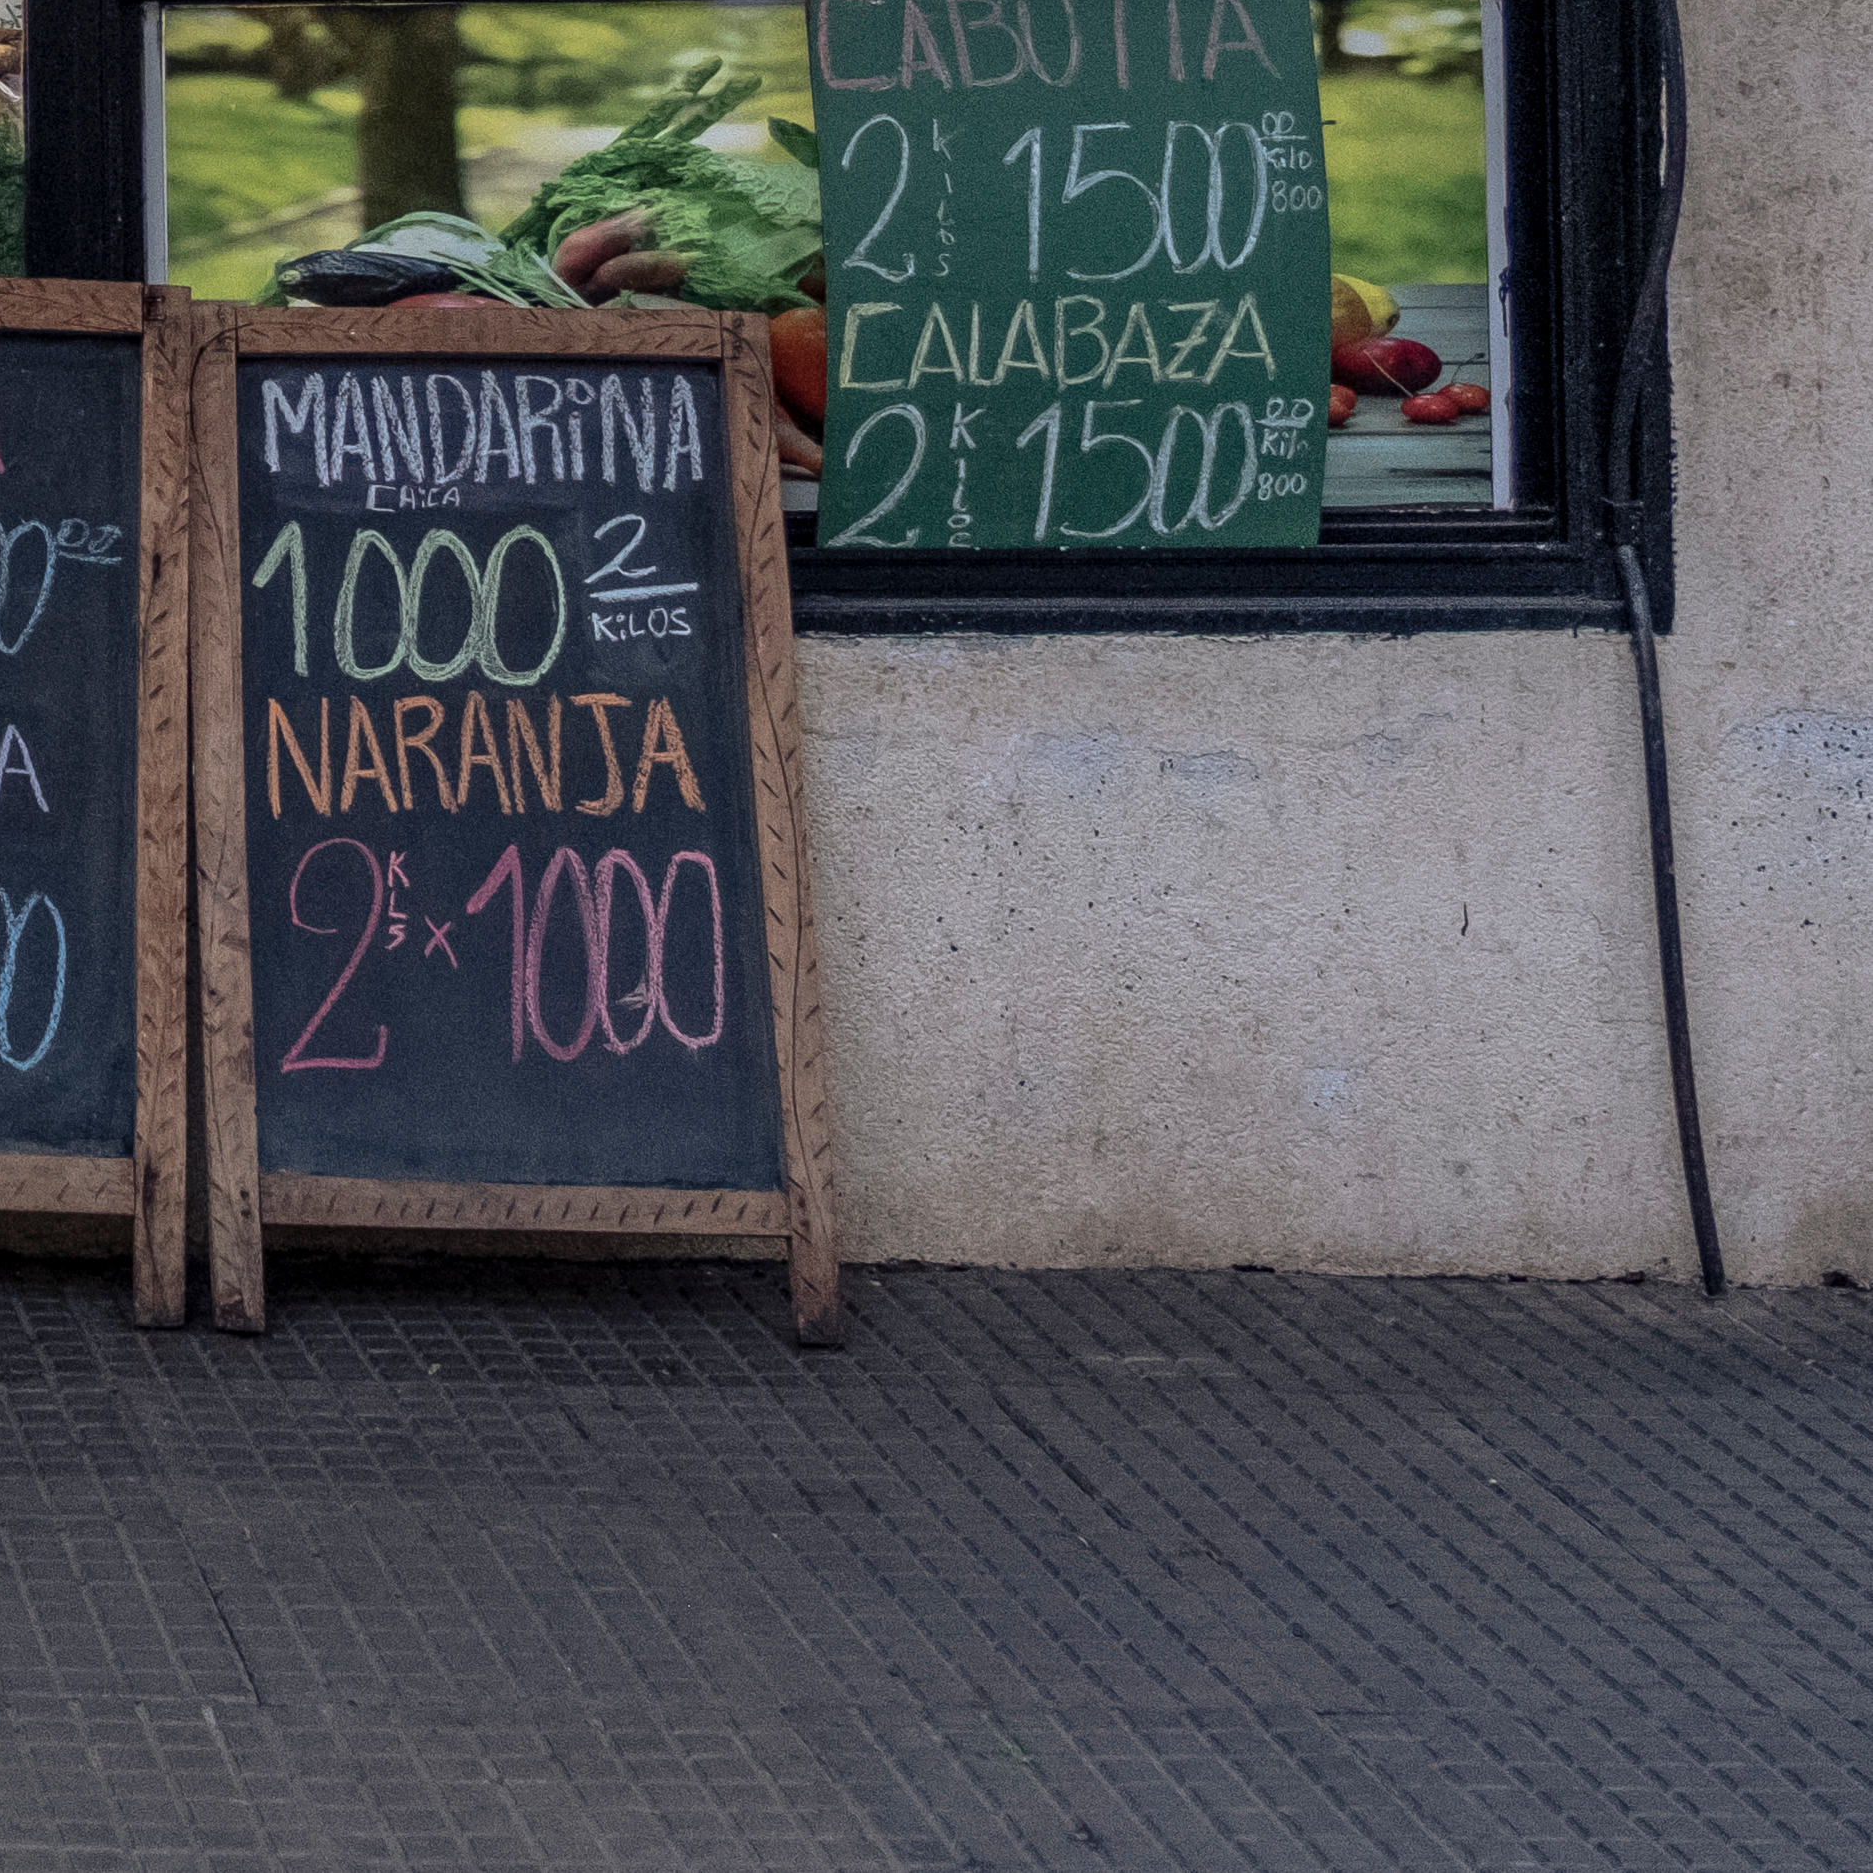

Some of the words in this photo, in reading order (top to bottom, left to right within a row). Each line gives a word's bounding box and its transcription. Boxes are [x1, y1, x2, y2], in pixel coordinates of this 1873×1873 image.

[842, 114, 916, 282] 2
[1002, 120, 1268, 283] 1500
[838, 292, 1277, 391] CALABAZA
[826, 402, 927, 548] 2
[1016, 399, 1256, 542] 1500
[1257, 474, 1307, 502] 800
[251, 520, 566, 687] 1000
[267, 692, 707, 821] NARANJA
[281, 837, 389, 1074] 2
[466, 843, 726, 1064] 1000
